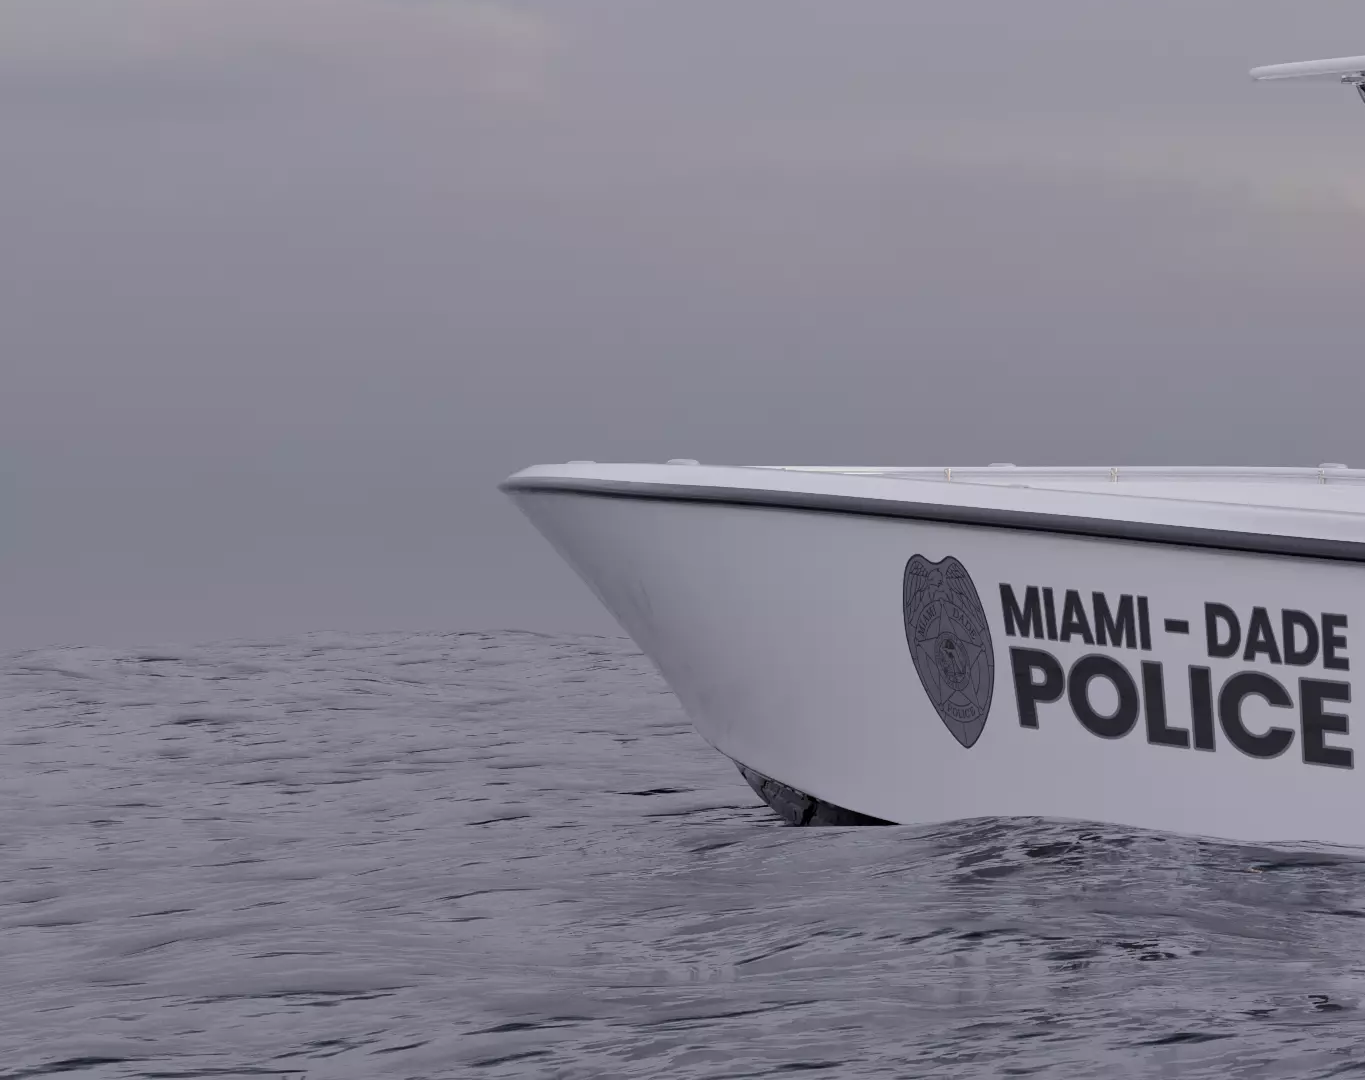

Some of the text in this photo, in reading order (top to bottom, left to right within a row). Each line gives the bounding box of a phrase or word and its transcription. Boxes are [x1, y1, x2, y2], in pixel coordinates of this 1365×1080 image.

[918, 604, 977, 640] MIAMI DADE
[999, 582, 1351, 671] MIAMI - DADE
[1009, 645, 1354, 770] POLICE
